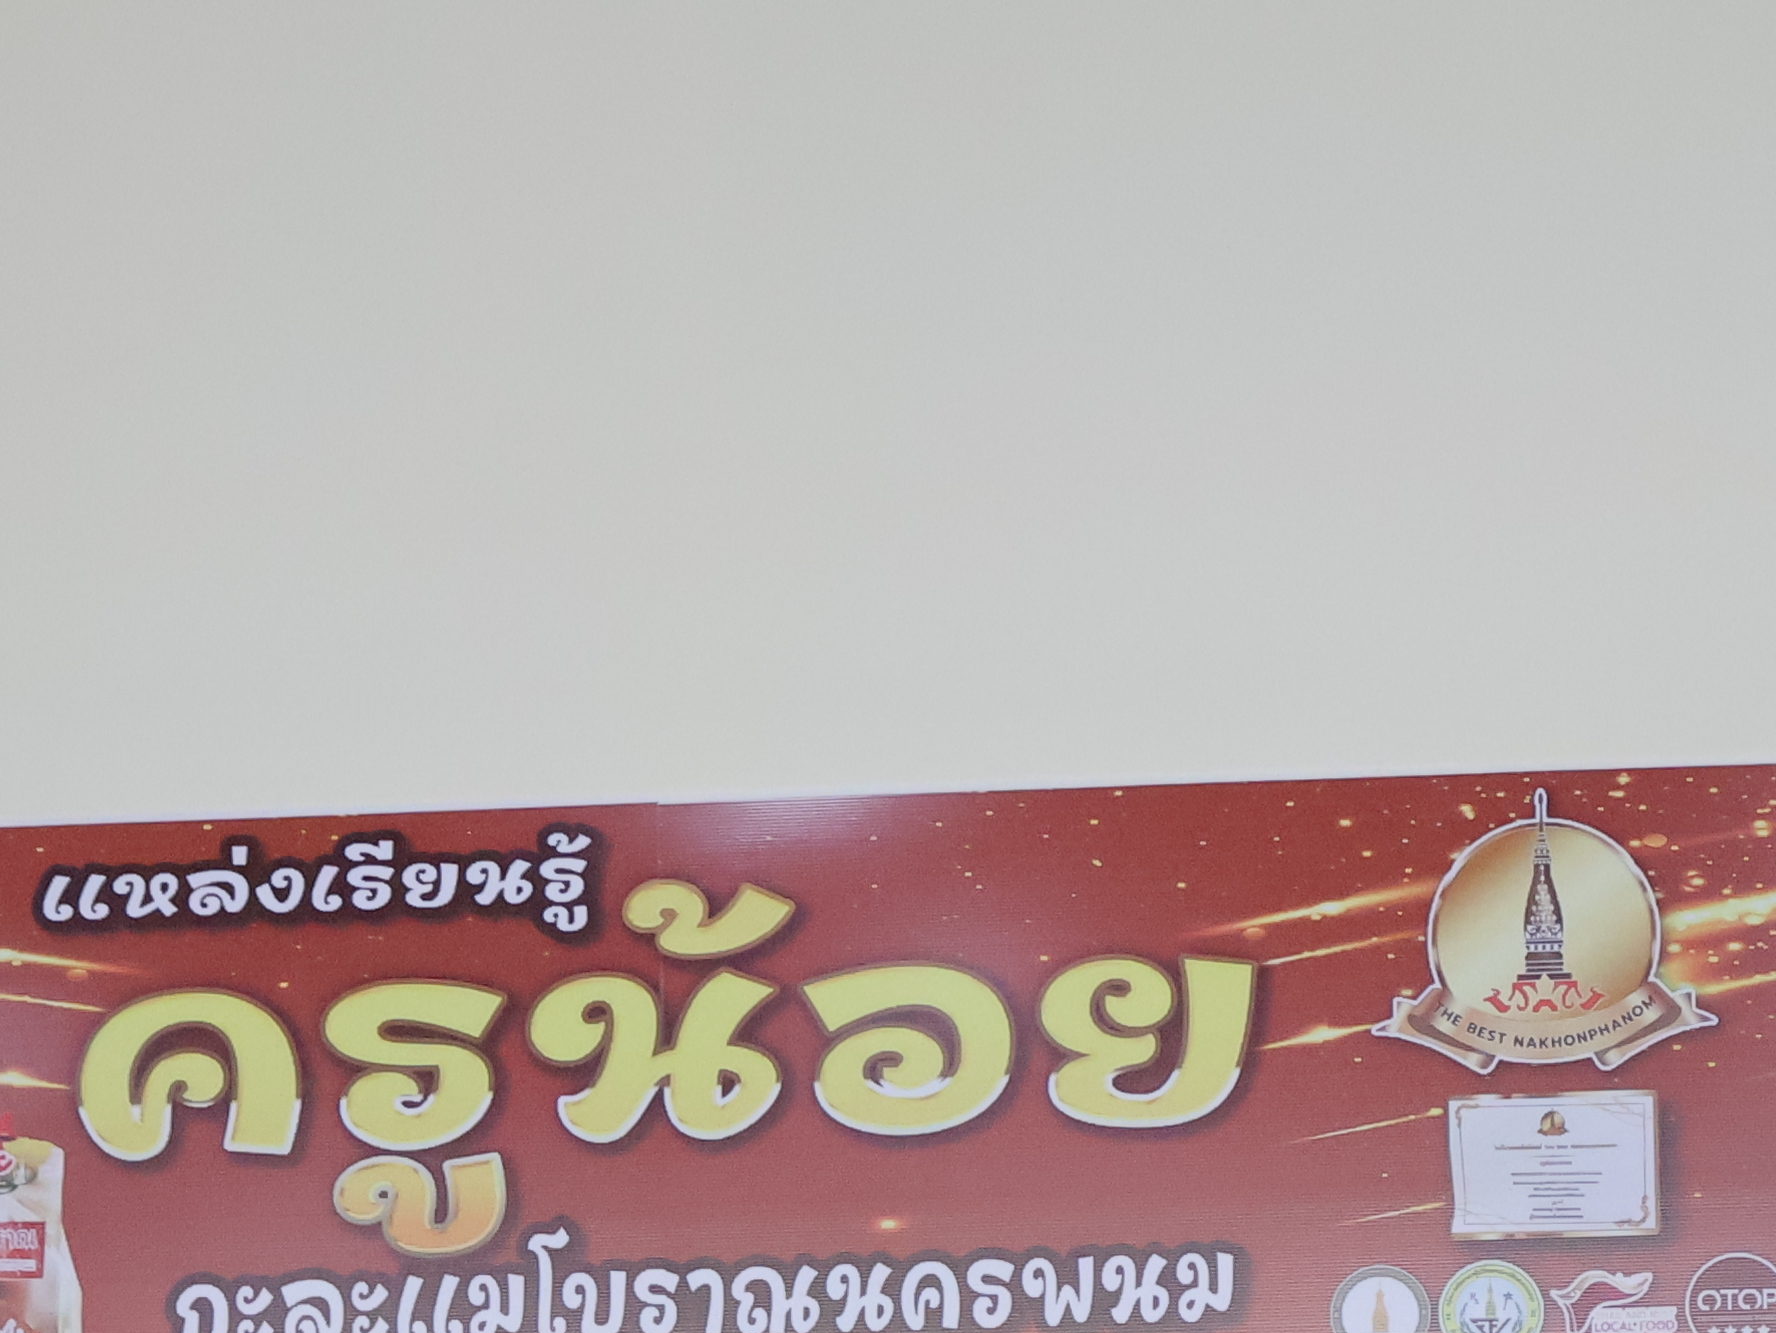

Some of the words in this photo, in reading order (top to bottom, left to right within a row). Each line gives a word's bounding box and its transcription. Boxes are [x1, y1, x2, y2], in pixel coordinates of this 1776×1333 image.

[43, 832, 591, 931] แหล่งเรียนรู้
[78, 876, 1258, 1256] ครูน้อย
[1435, 1001, 1463, 1027] THE
[1466, 1020, 1506, 1045] BEST
[1513, 993, 1658, 1049] NAKHONPHANOM
